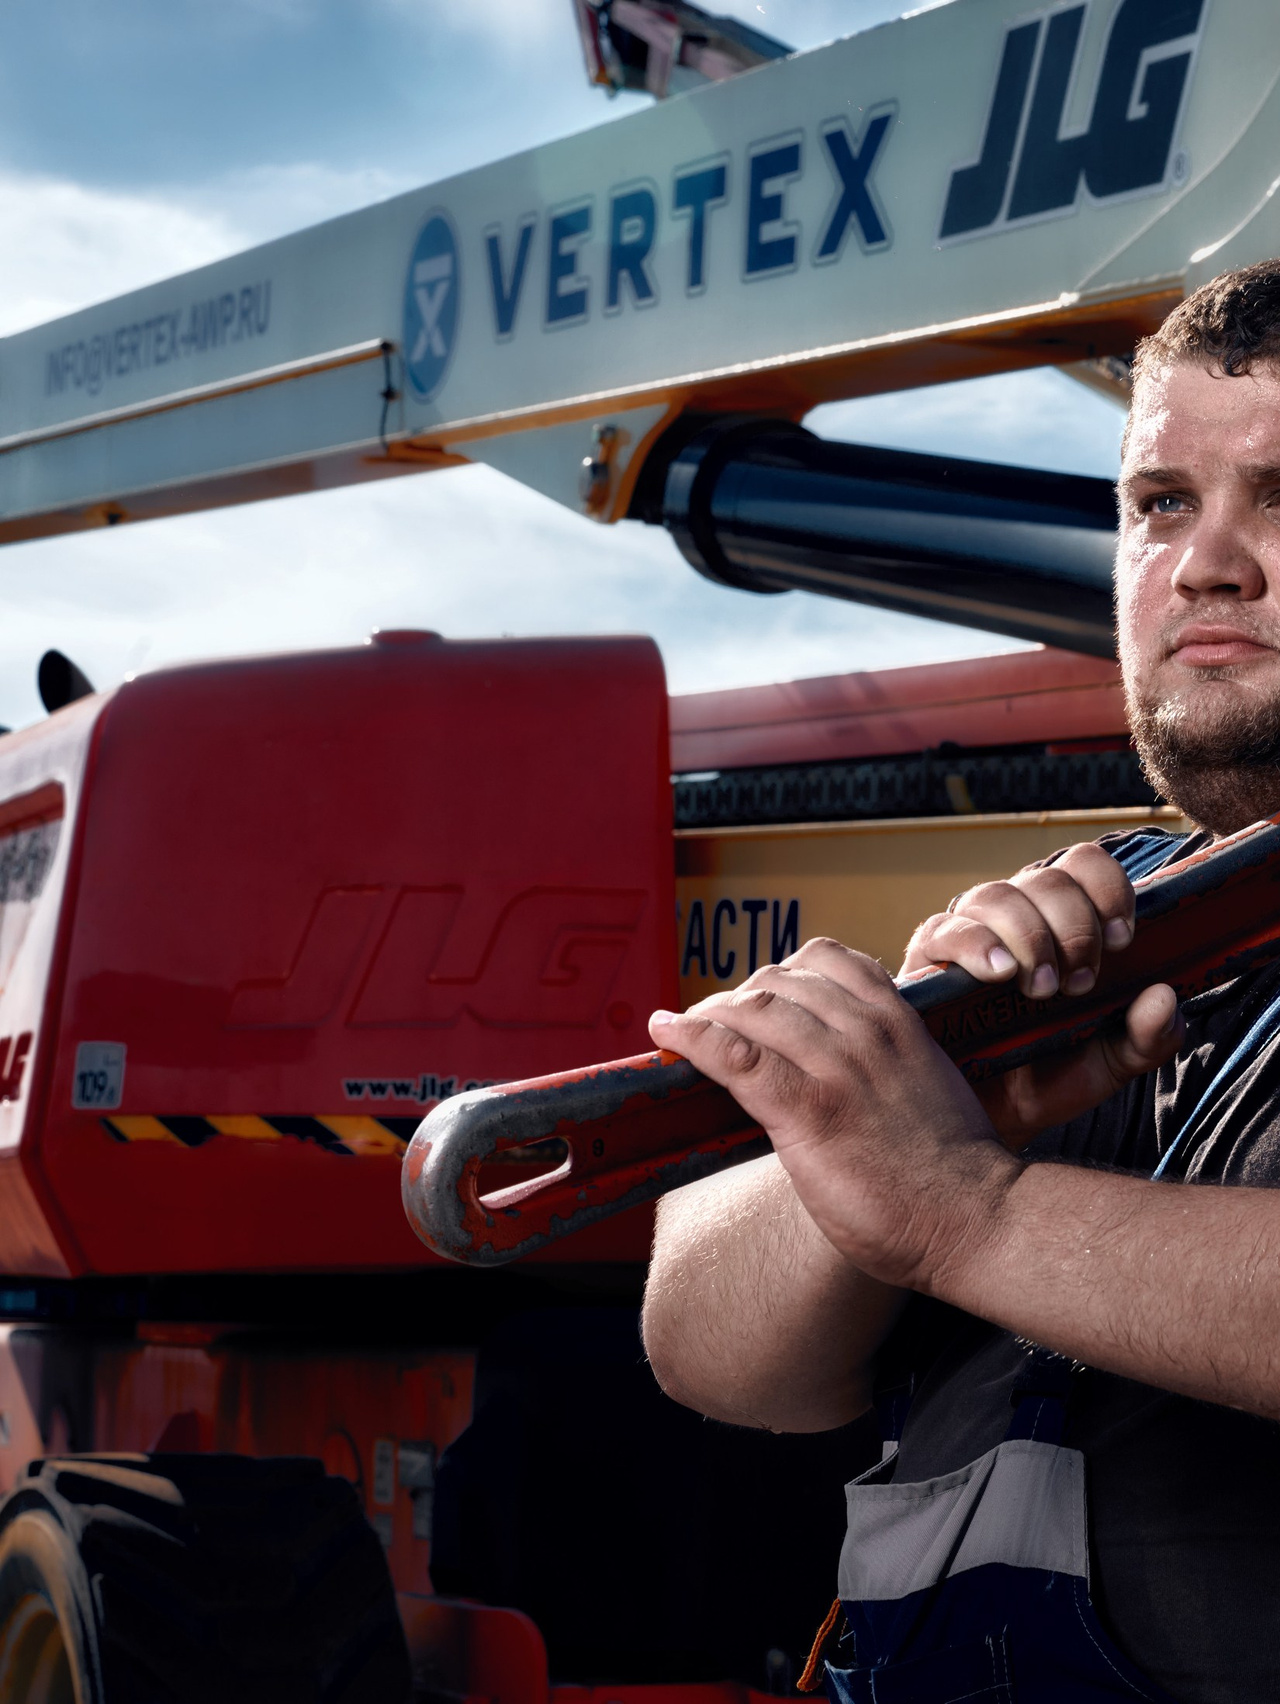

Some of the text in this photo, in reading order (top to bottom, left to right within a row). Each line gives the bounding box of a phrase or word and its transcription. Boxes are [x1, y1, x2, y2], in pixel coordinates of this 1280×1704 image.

[937, 0, 1203, 242] JLG
[483, 110, 896, 339] VERTEX
[223, 884, 649, 1028] JLG
[676, 899, 799, 979] АСТИ
